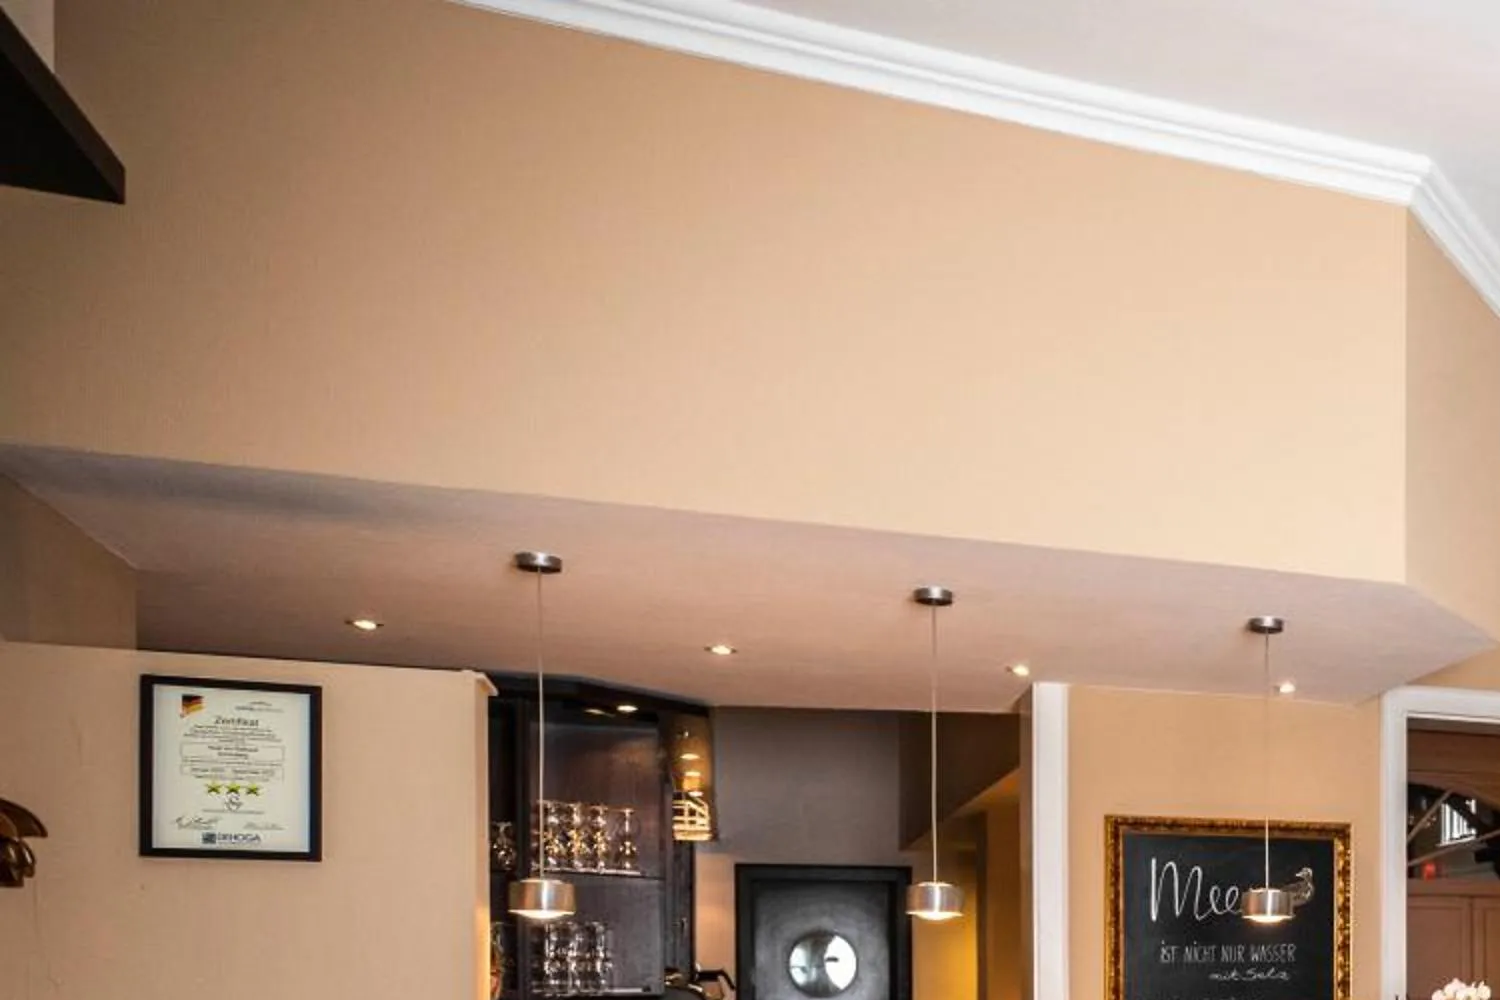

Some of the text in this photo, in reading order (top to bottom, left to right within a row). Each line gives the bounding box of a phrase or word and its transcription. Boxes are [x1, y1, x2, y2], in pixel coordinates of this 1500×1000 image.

[1151, 857, 1242, 921] Mee
[1221, 944, 1246, 962] NUR
[1251, 943, 1297, 963] WASSER
